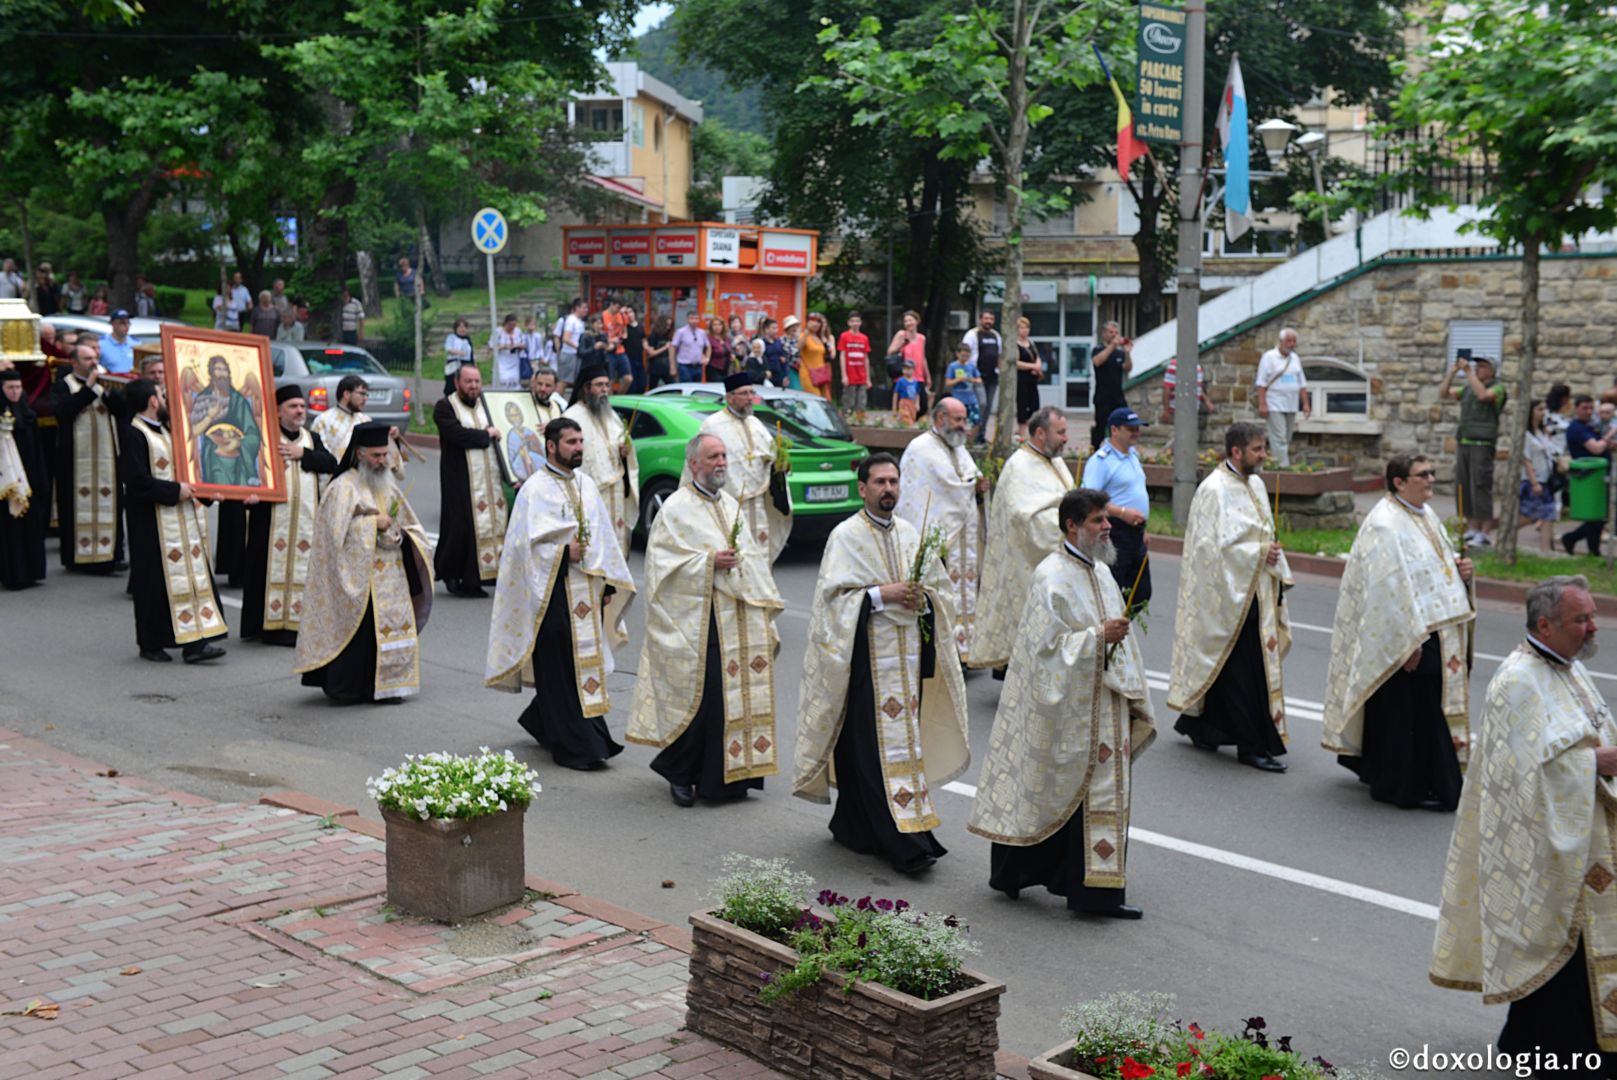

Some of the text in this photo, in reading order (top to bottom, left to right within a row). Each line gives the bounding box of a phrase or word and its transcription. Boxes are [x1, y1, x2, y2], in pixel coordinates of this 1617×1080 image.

[1141, 60, 1182, 82] PARCARE
[1140, 78, 1182, 99] 50 locuri
[577, 241, 603, 250] vodafone
[621, 240, 648, 249] vodafone
[666, 239, 694, 248] vodafone
[775, 254, 806, 264] vodafone
